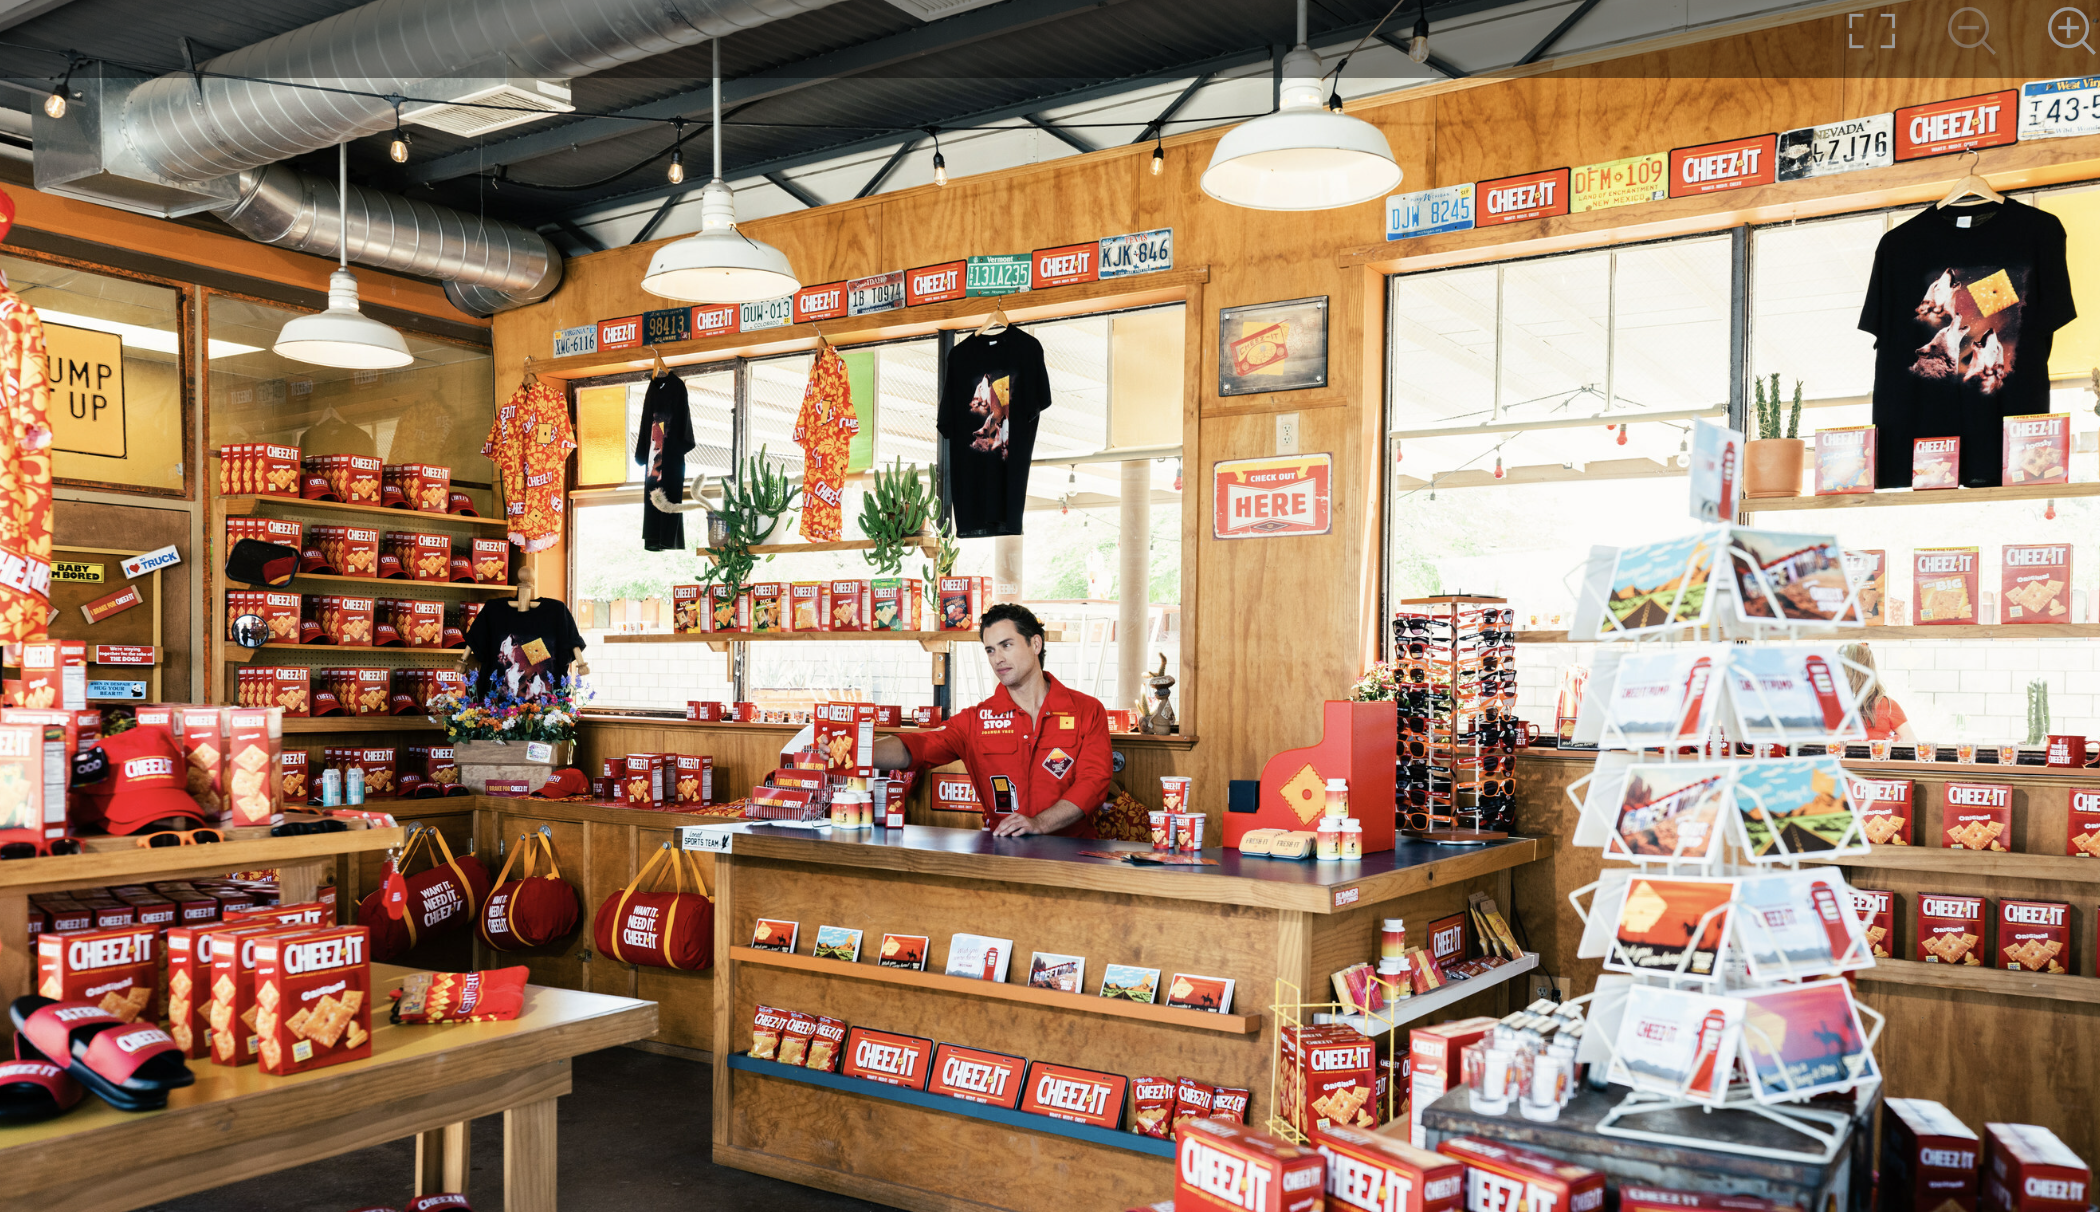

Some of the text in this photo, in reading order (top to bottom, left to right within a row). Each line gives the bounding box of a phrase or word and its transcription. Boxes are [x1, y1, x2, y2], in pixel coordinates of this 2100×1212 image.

[2057, 78, 2100, 91] West Vir
[1813, 123, 1864, 140] NEVADA
[1910, 106, 2000, 145] CHEEZ-IT
[1683, 149, 1761, 184] CHEEZ-IT
[1487, 182, 1556, 214] CHEEZ-IT
[1579, 193, 1596, 201] LAND
[1609, 185, 1659, 196] ENCHANTMENT
[1614, 194, 1645, 204] MEXICO
[1392, 197, 1469, 230] DJW 8245
[1125, 234, 1148, 244] TEXAS
[1040, 253, 1090, 278] CHEEZ-IT
[913, 271, 957, 295] CHEEZ-IT
[973, 265, 1028, 286] 131A235
[800, 291, 840, 313] CHEEZ-IT
[853, 291, 864, 307] 1B
[650, 316, 684, 336] 98413
[697, 309, 733, 330] CHEEZ-IT
[754, 320, 779, 328] COLORADO
[603, 324, 636, 344] CHEEZ-IT
[1239, 332, 1280, 356] CHEEZ-IT
[49, 355, 112, 390] UMP
[70, 391, 107, 421] UP
[2009, 420, 2062, 437] CHEEZ-IT
[267, 445, 298, 461] CHEEZ-IT
[1916, 440, 1956, 453] CHEEZ-IT
[351, 456, 380, 470] CHEEZ-IT
[422, 466, 449, 480] CHEEZ-IT
[1251, 472, 1295, 483] CHECK OUT
[1236, 492, 1307, 518] HERE
[268, 522, 300, 536] CHEEZ-IT
[347, 529, 376, 543] CHEEZ-IT
[419, 536, 449, 549] CHEEZ-IT
[475, 540, 507, 553] CHEEZ-IT
[141, 552, 177, 569] TRUCK
[1917, 555, 1973, 573] CHEEZ-IT
[2006, 546, 2066, 566] CHEEZ-IT
[57, 564, 90, 572] BABY
[63, 572, 100, 580] BORED
[675, 587, 697, 598] CHEEZ-IT
[755, 585, 778, 596] CHEEZ-IT
[794, 586, 818, 597] CHEEZ-IT
[833, 582, 859, 594] CHEEZ-IT
[875, 587, 897, 598] CHEEZ-IT
[941, 579, 969, 591] CHEEZ-IT
[1935, 579, 1962, 590] BIG
[267, 593, 299, 608] CHEEZ-IT
[342, 599, 372, 613] CHEEZ-IT
[415, 602, 442, 615] CHEEZ-IT
[93, 604, 108, 615] BRAKE
[276, 669, 307, 681] CHEEZ-IT
[359, 670, 388, 681] CHEEZ-IT
[829, 704, 855, 724] CHEEZ-IT
[984, 720, 1011, 730] STOP
[363, 750, 393, 762] CHEEZ-IT
[628, 757, 649, 770] CHEEZ-IT
[678, 757, 700, 770] CHEEZ-IT
[124, 757, 173, 778] CHEEZ-IT
[758, 798, 773, 806] BRAKE
[1948, 786, 2008, 806] CHEEZ-IT
[705, 838, 719, 847] TEAM
[421, 884, 443, 899] WANT
[422, 894, 447, 912] NEED
[633, 904, 649, 916] WANT
[1922, 898, 1981, 919] CHEEZ-IT
[424, 900, 463, 928] CHEEZ-IT
[2004, 905, 2065, 925] CHEEZ-IT
[627, 915, 648, 930] NEED
[623, 928, 658, 949] CHEEZ-IT
[1434, 926, 1461, 958] CHEEZ-IT
[68, 933, 154, 971] CHEEZ-IT
[284, 936, 364, 975] CHEEZ-IT
[754, 1012, 787, 1030] CHEEZ-IT
[856, 1040, 919, 1077] CHEEZ-IT
[1311, 1047, 1371, 1071] CHEEZ-IT
[942, 1057, 1010, 1096] CHEEZ-IT
[1036, 1075, 1111, 1115] CHEEZ-IT
[1136, 1084, 1174, 1099] CHEEZ-IT
[1178, 1087, 1212, 1109] CHEEZ-IT
